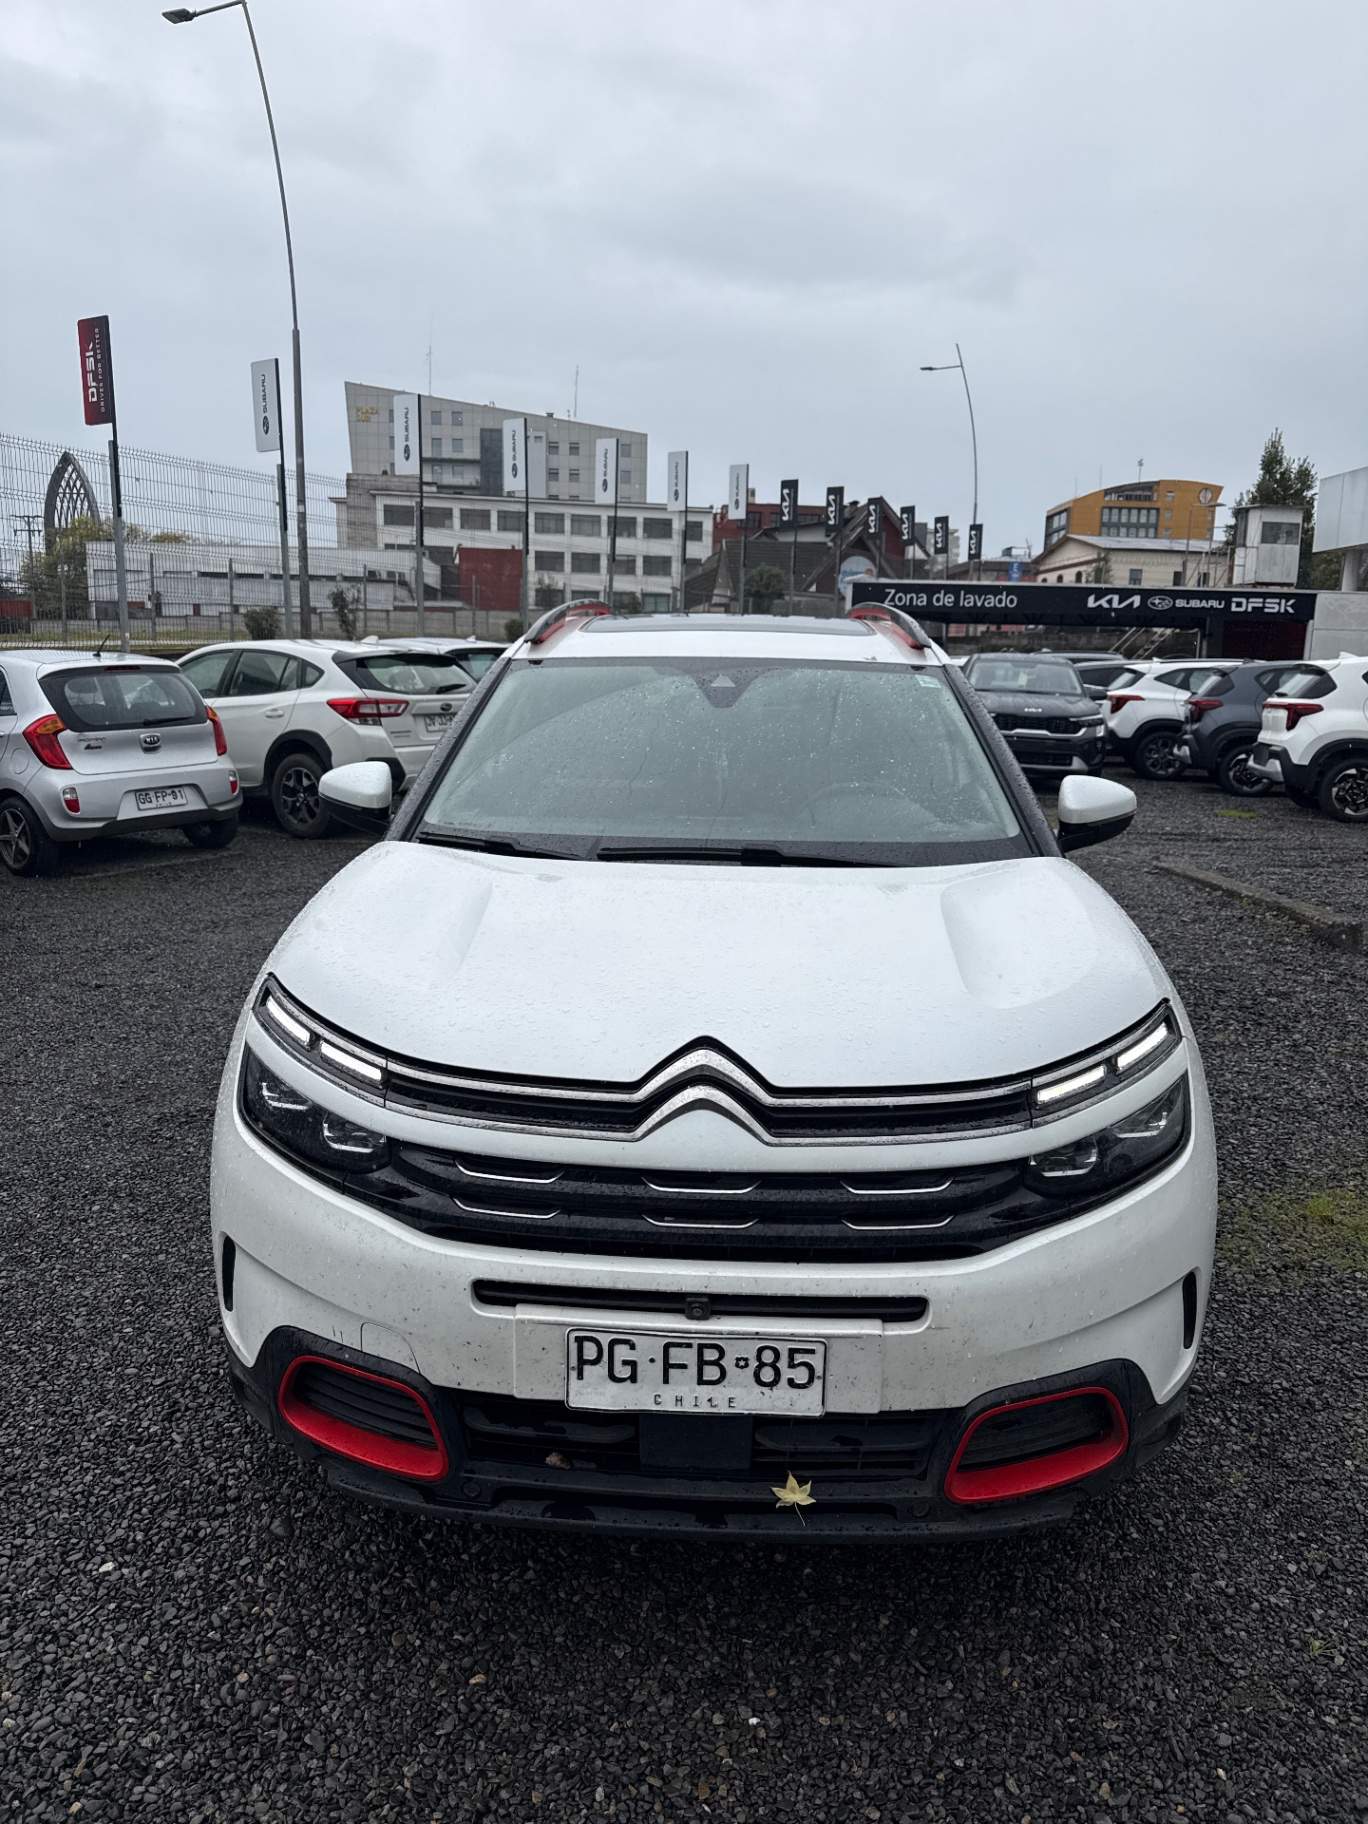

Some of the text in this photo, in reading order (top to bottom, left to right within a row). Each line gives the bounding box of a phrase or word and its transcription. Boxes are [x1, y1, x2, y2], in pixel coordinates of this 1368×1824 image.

[782, 488, 790, 521] KIA
[828, 494, 836, 525] KIA
[868, 504, 876, 534] KIA
[901, 513, 909, 540] KIA
[935, 523, 943, 548] KIA
[969, 530, 977, 555] KIA
[884, 588, 1019, 608] Zona de lavado
[1087, 594, 1297, 614] KIA SUBARU DFSK
[653, 1393, 737, 1409] CHILE
